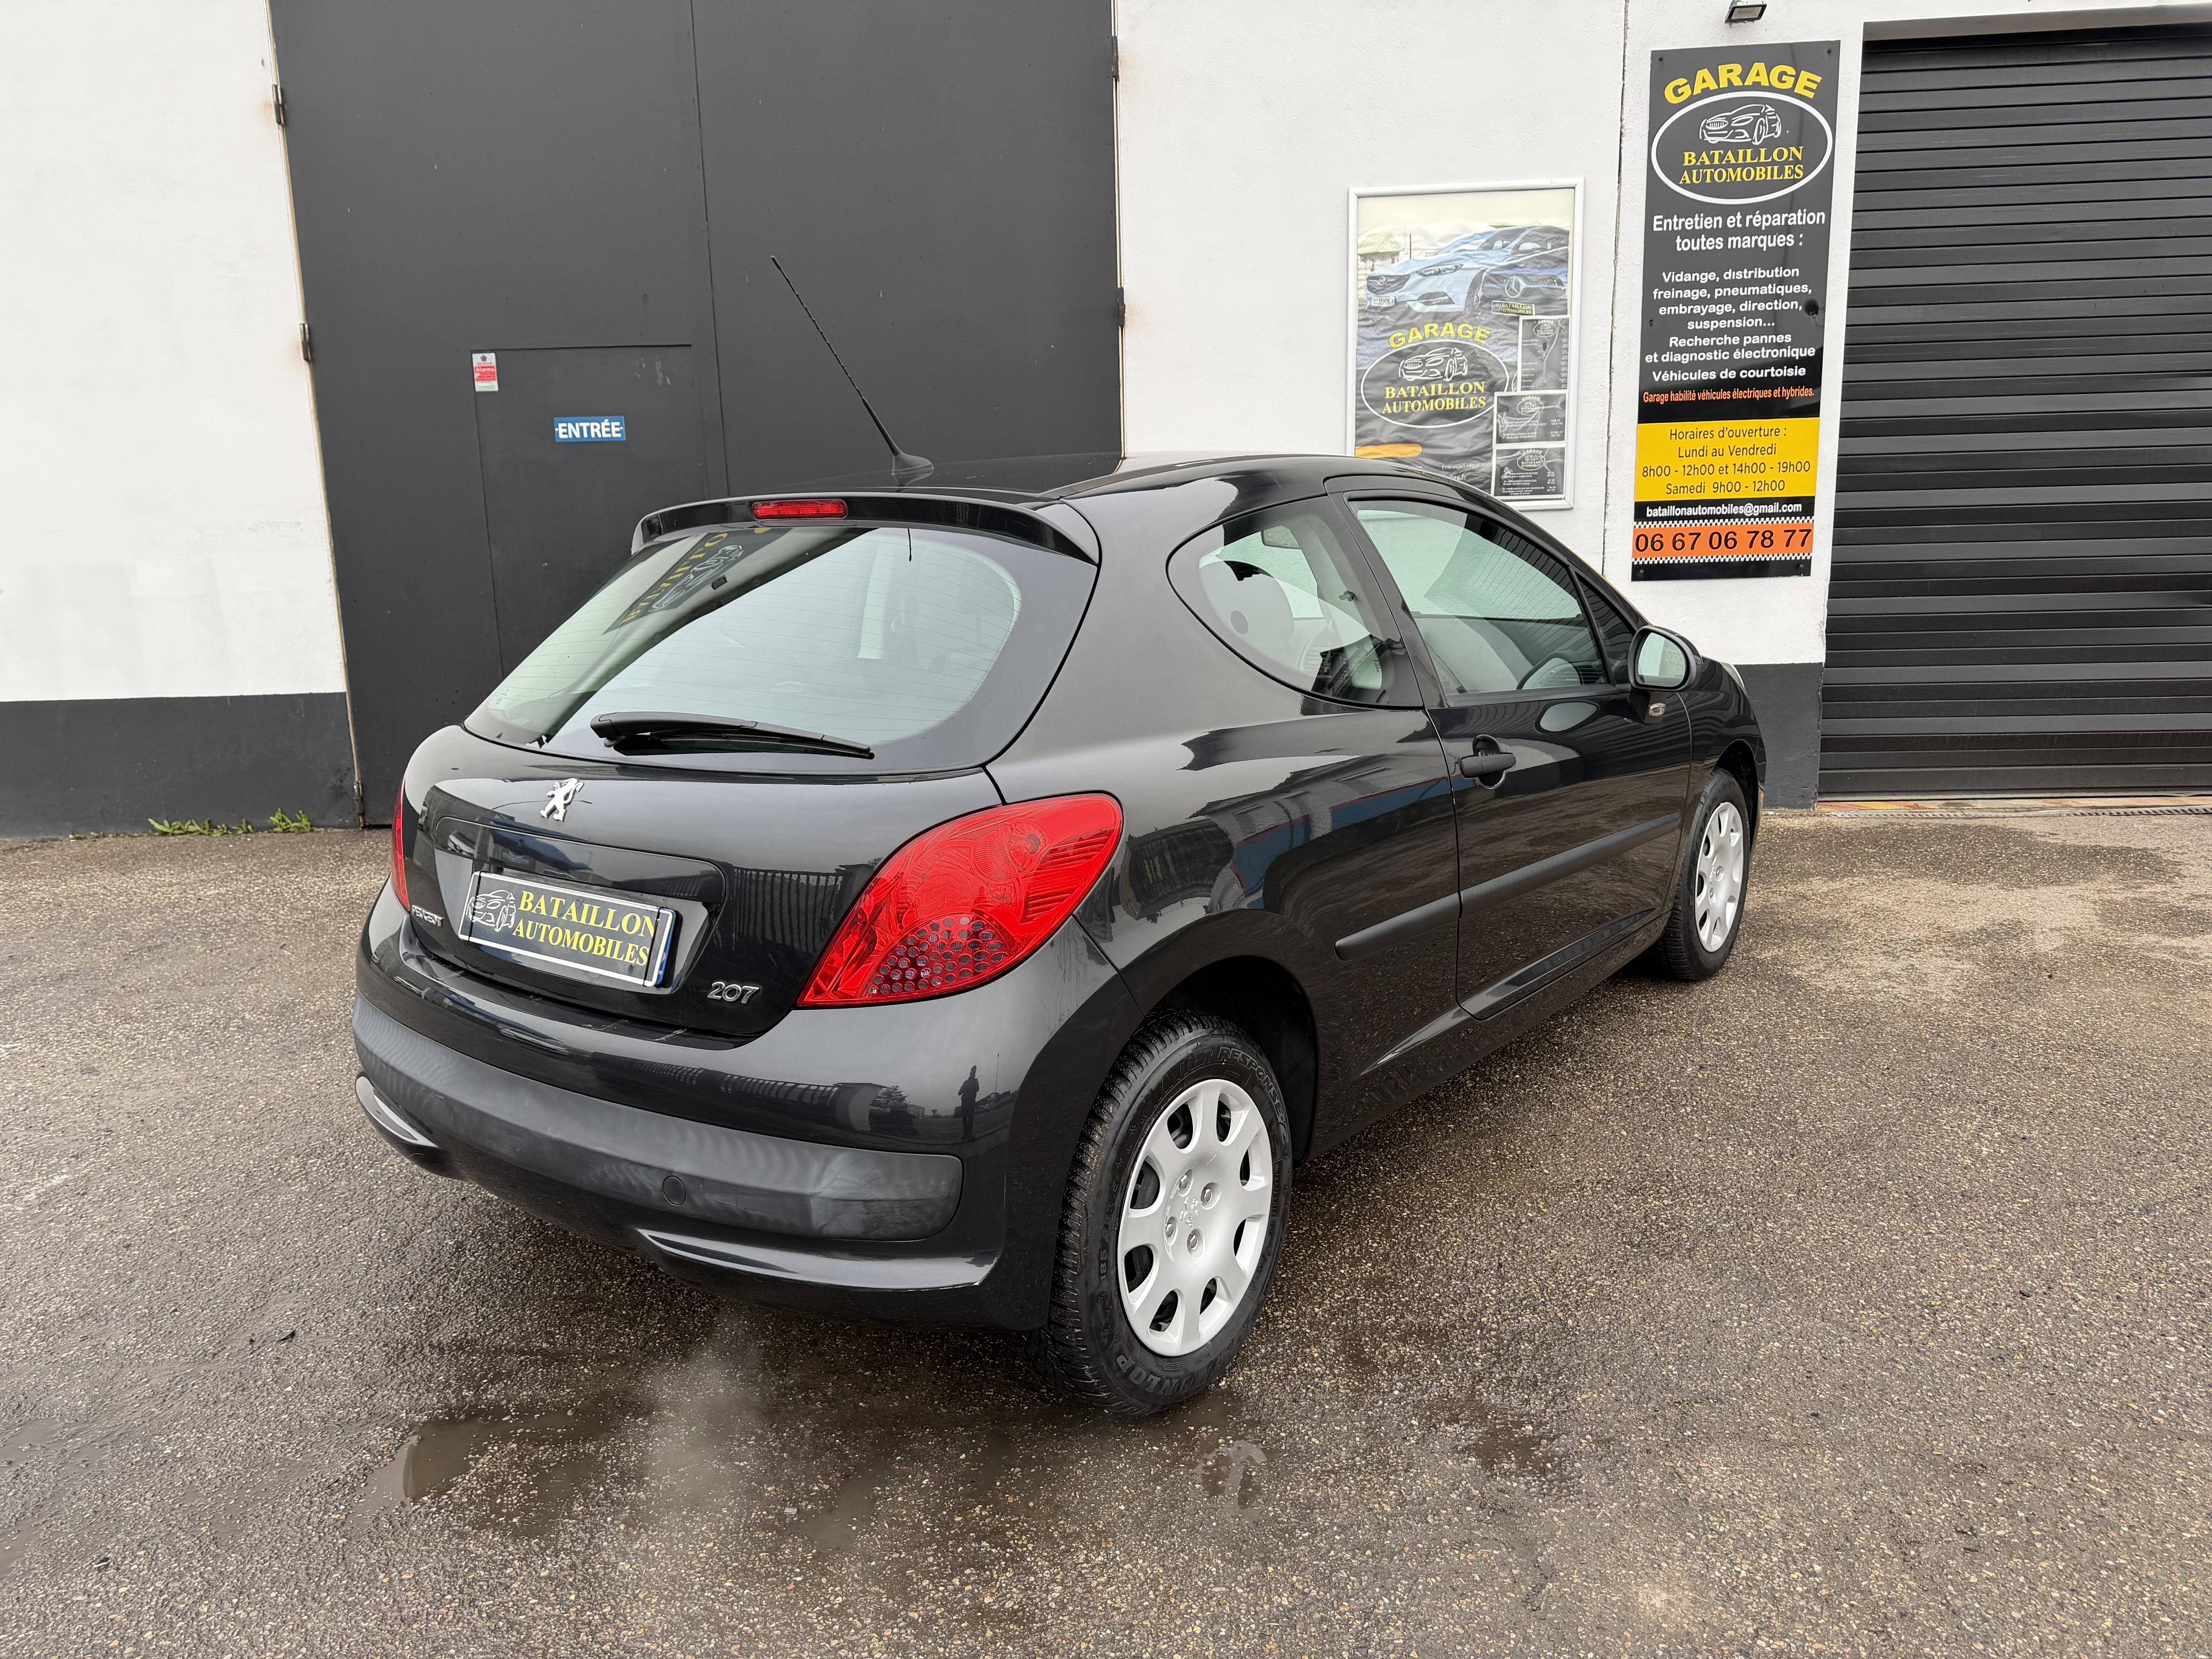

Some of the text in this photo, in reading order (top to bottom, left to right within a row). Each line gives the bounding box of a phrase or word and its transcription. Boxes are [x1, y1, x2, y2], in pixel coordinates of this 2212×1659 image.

[1664, 62, 1822, 104] GARAGE
[1683, 146, 1804, 166] BATAILLON
[1679, 164, 1804, 184] AUTOMOBILES
[1653, 209, 1825, 231] Entretien et réparation
[1676, 234, 1723, 251] toutes
[1728, 233, 1794, 251] marques
[1662, 267, 1800, 283] Vidange, distribution
[1653, 283, 1812, 300] freinage, pneumatiques,
[1658, 299, 1802, 315] embrayage, direction,
[1687, 317, 1775, 331] suspension...
[1389, 322, 1491, 349] GARAGE
[1669, 334, 1791, 347] Recherche pannes
[1645, 346, 1816, 363] et diagnostic électronique
[1653, 366, 1806, 381] Véhicules de courtoisie
[1385, 381, 1485, 399] BATAILLON
[1643, 385, 1814, 404] Garage habilité véhicules électriques et hybrides.
[1382, 396, 1486, 414] AUTOMOBILES
[558, 419, 622, 438] ENTRÉE
[1670, 427, 1714, 440] Horaires
[1718, 427, 1781, 438] d'ouverture
[1678, 443, 1777, 458] Lundi au Vendredi
[1642, 465, 1671, 477] 8h00
[1682, 464, 1714, 476] 12h00
[1718, 464, 1729, 475] et
[1733, 463, 1766, 474] 14h00
[1778, 461, 1810, 472] 19h00
[1666, 482, 1705, 494] Samedi
[1712, 481, 1741, 493] 9h00
[1752, 480, 1785, 491] 12h00
[1646, 502, 1802, 517] bataillonautomobiles@gmail.com
[1635, 529, 1812, 552] 06 67 06 78 77
[519, 890, 661, 938] BATAILLON
[513, 918, 650, 967] AUTOMOBILES
[707, 980, 761, 1003] 207
